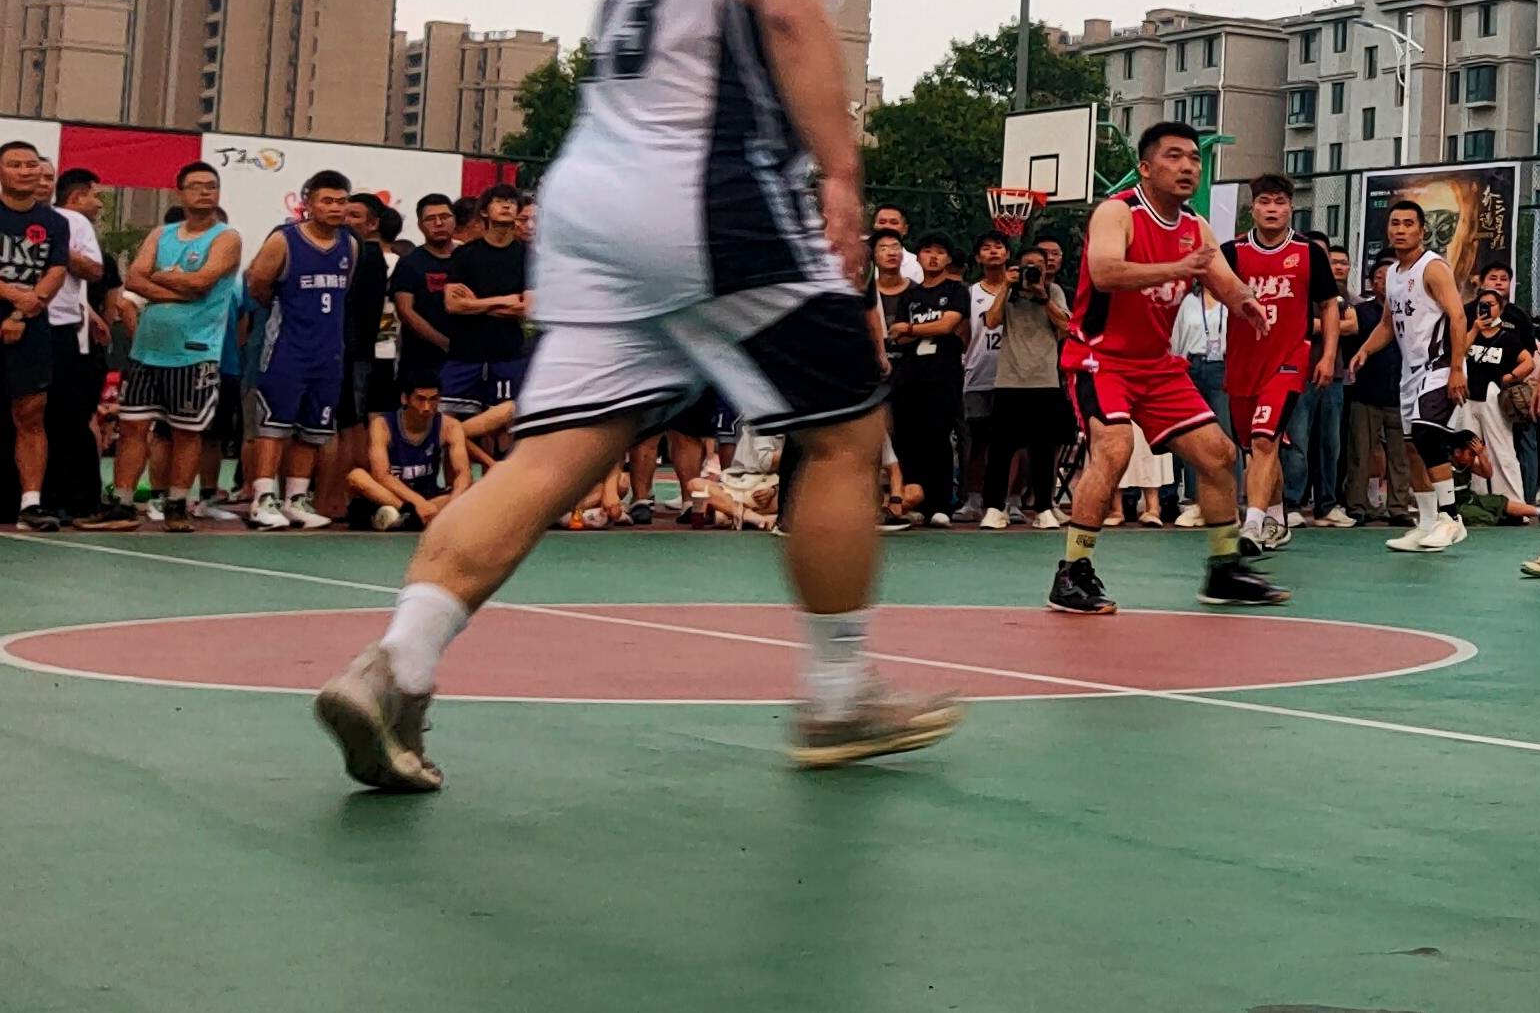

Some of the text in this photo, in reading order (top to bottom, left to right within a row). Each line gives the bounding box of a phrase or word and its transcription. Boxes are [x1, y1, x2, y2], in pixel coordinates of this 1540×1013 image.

[321, 292, 331, 313] 9
[985, 332, 1002, 350] 12
[496, 380, 511, 399] 11
